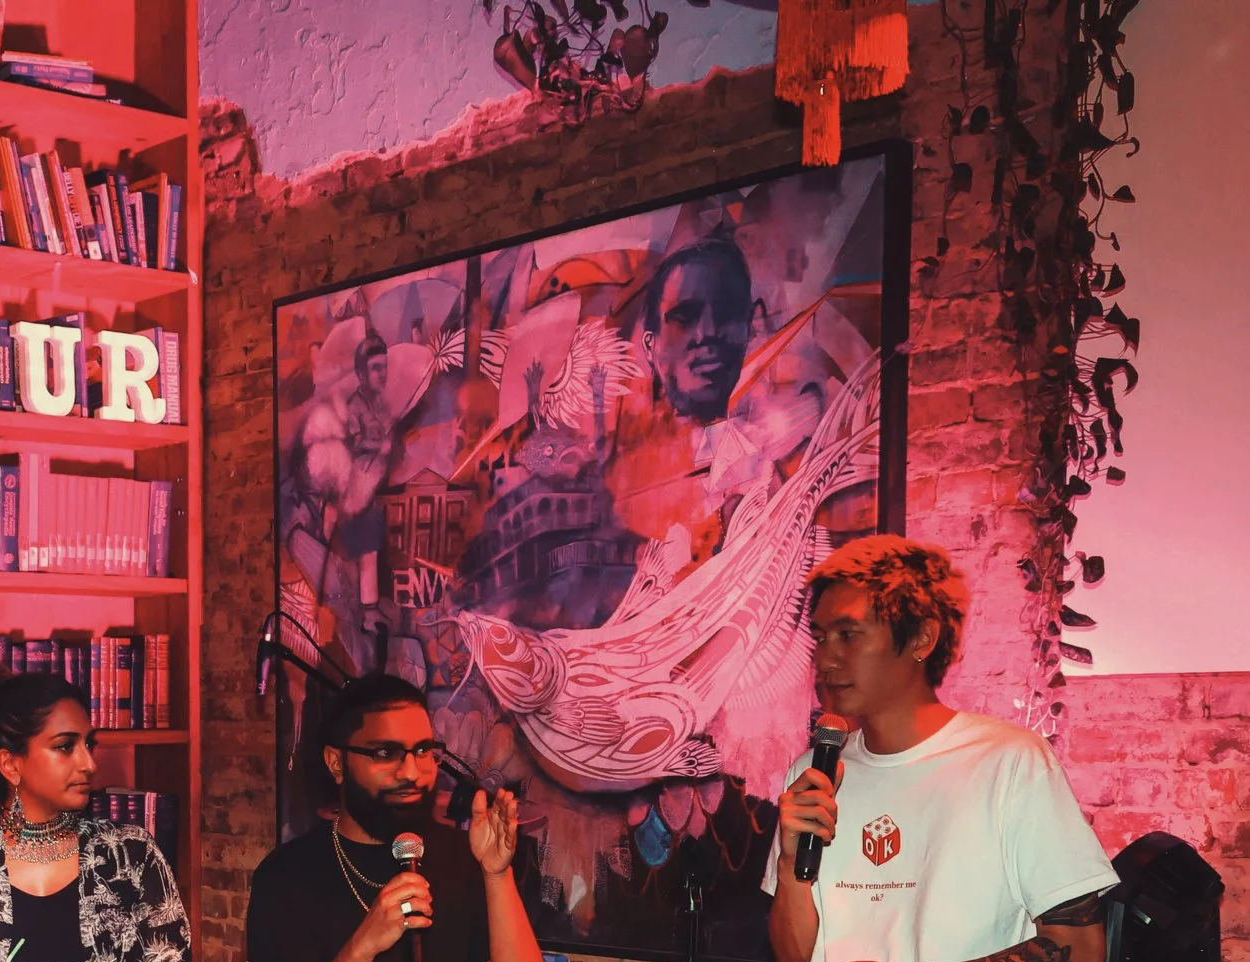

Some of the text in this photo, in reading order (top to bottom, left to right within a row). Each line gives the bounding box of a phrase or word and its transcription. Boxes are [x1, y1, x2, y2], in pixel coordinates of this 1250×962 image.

[165, 341, 179, 424] DRUG MANUAL
[392, 567, 448, 609] ENVY
[835, 880, 863, 890] always
[865, 880, 904, 889] remember
[870, 893, 883, 902] ok?
